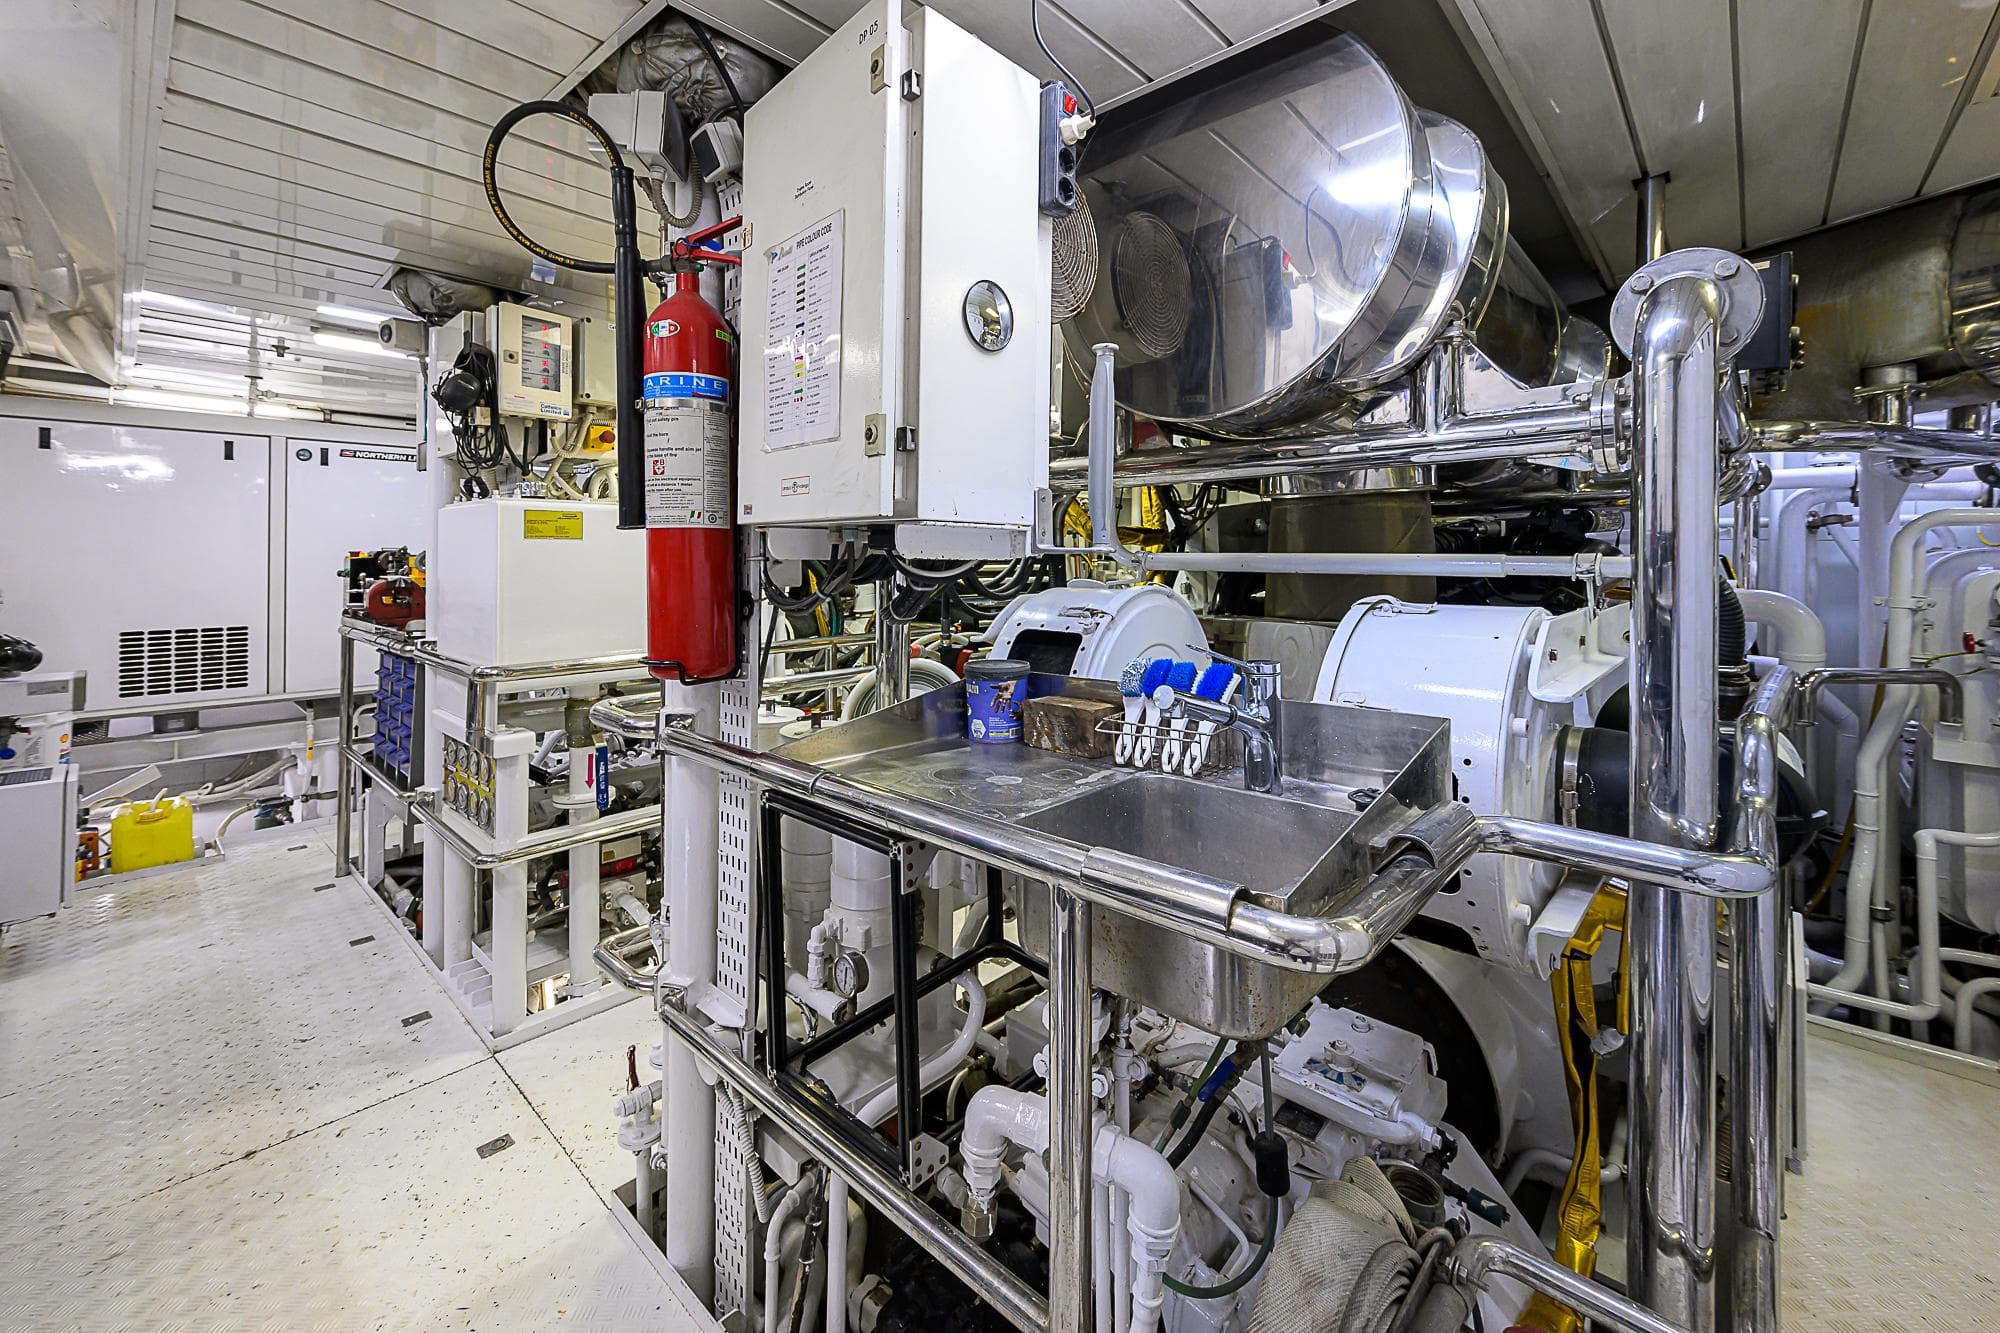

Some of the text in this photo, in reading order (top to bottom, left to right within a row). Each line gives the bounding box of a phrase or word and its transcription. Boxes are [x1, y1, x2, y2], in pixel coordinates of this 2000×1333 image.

[859, 19, 879, 45] DP 05
[796, 222, 832, 249] PIPE COLOUR CODE
[646, 376, 723, 390] ARINE
[355, 451, 407, 461] NORTHERN
